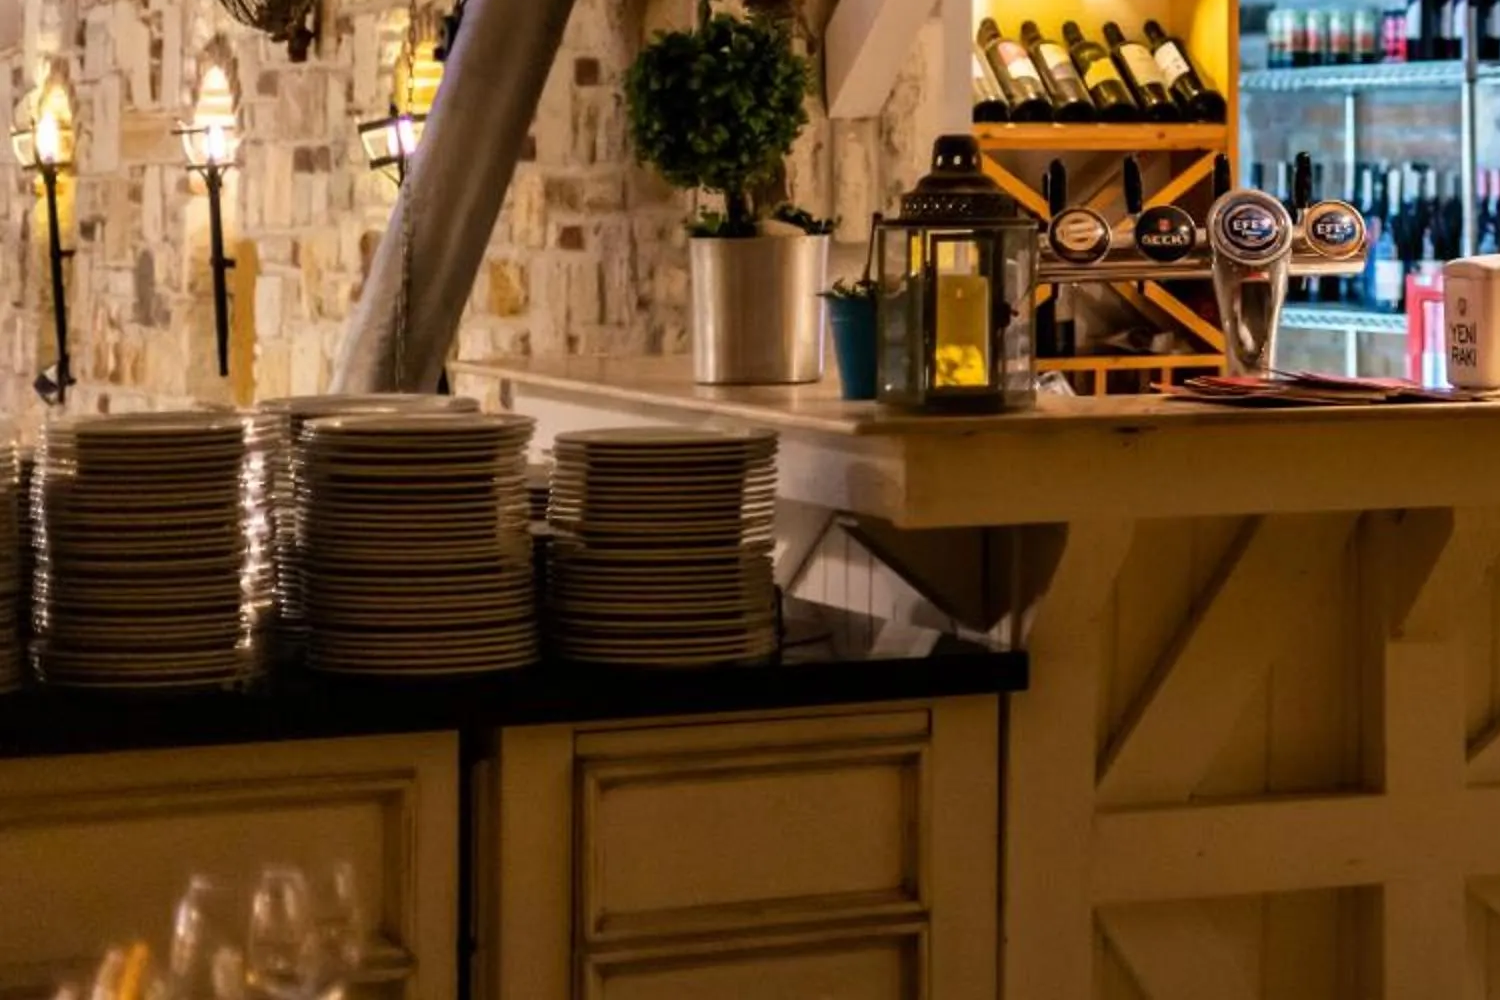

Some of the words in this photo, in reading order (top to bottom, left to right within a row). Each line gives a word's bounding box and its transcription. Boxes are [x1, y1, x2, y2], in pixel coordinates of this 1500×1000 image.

[1233, 218, 1272, 231] EFES
[1317, 222, 1353, 235] EFES
[1452, 321, 1477, 344] YENİ
[1452, 346, 1477, 367] RAKI
